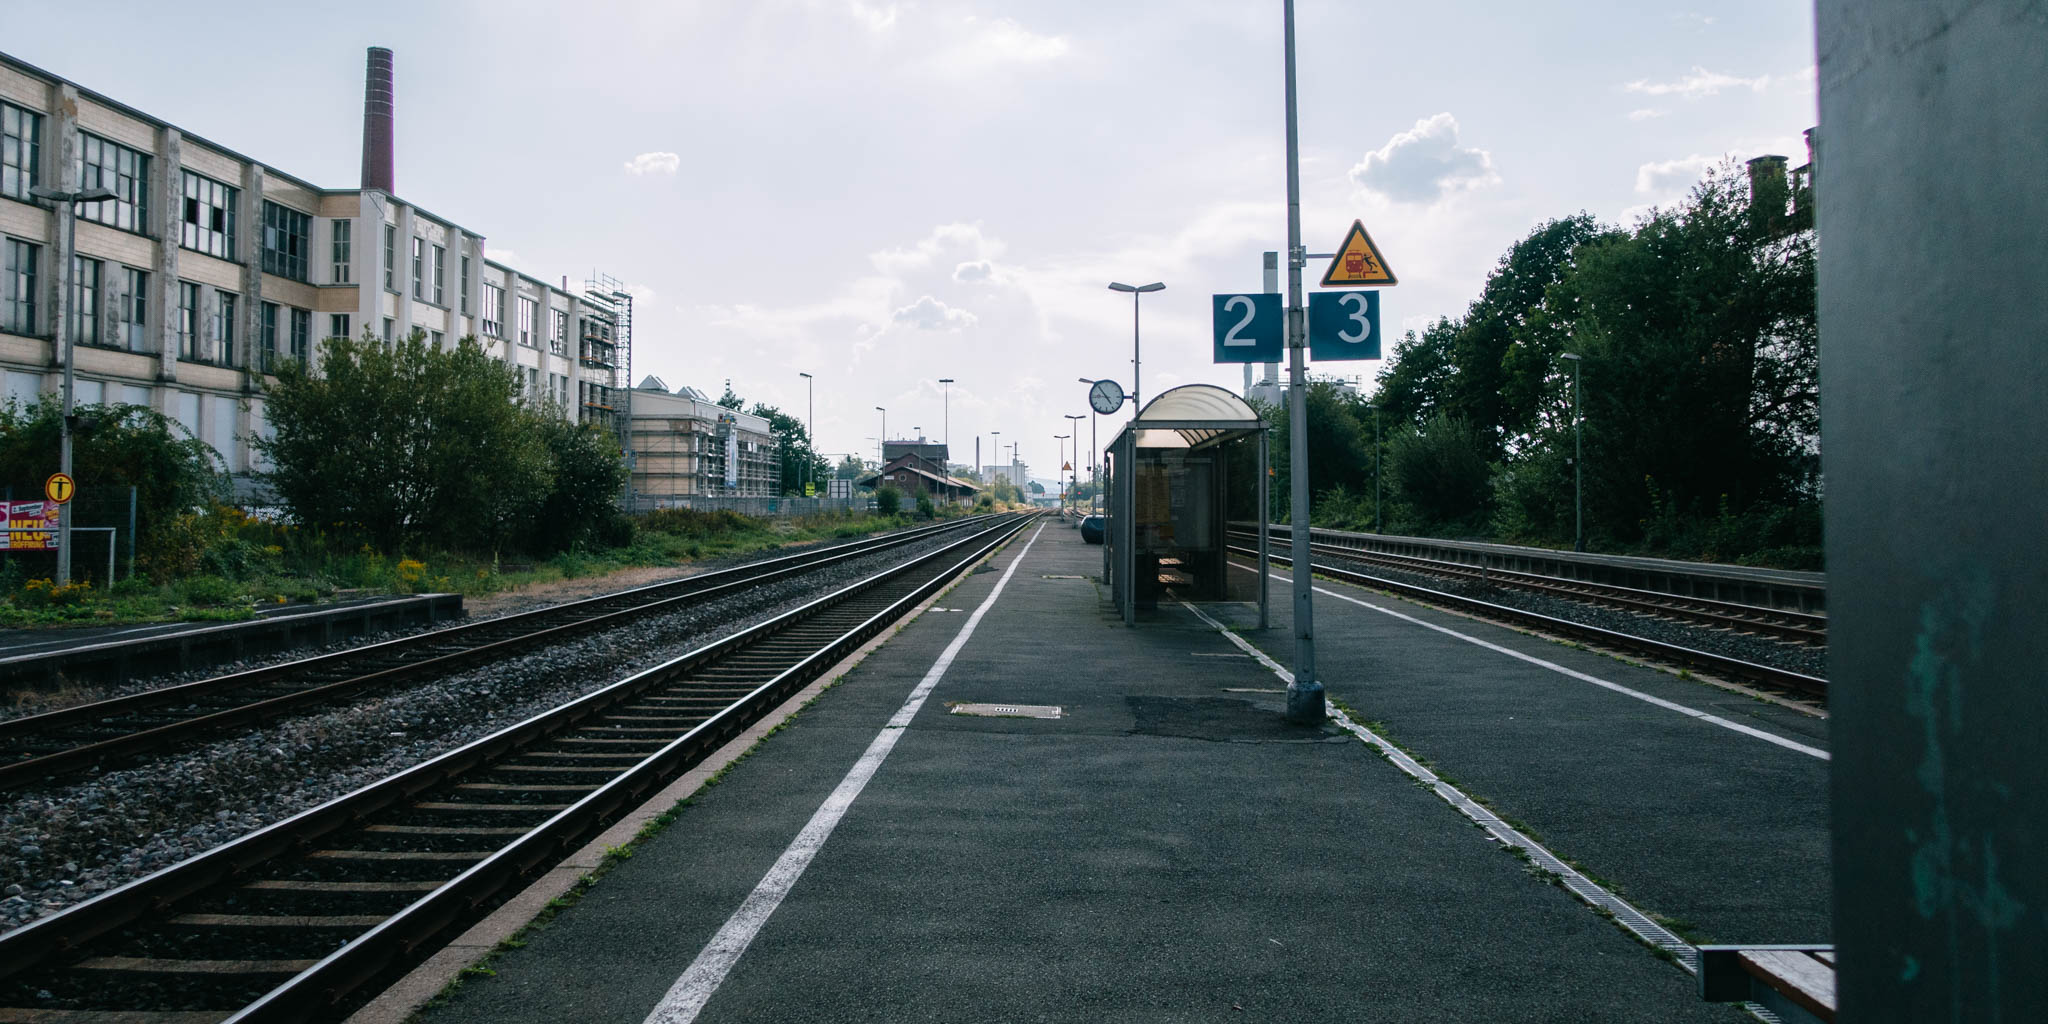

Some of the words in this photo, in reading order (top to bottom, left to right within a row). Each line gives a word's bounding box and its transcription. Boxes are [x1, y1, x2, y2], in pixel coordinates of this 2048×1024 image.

[1223, 296, 1256, 346] 2
[1337, 293, 1371, 343] 3
[10, 519, 44, 540] NEU
